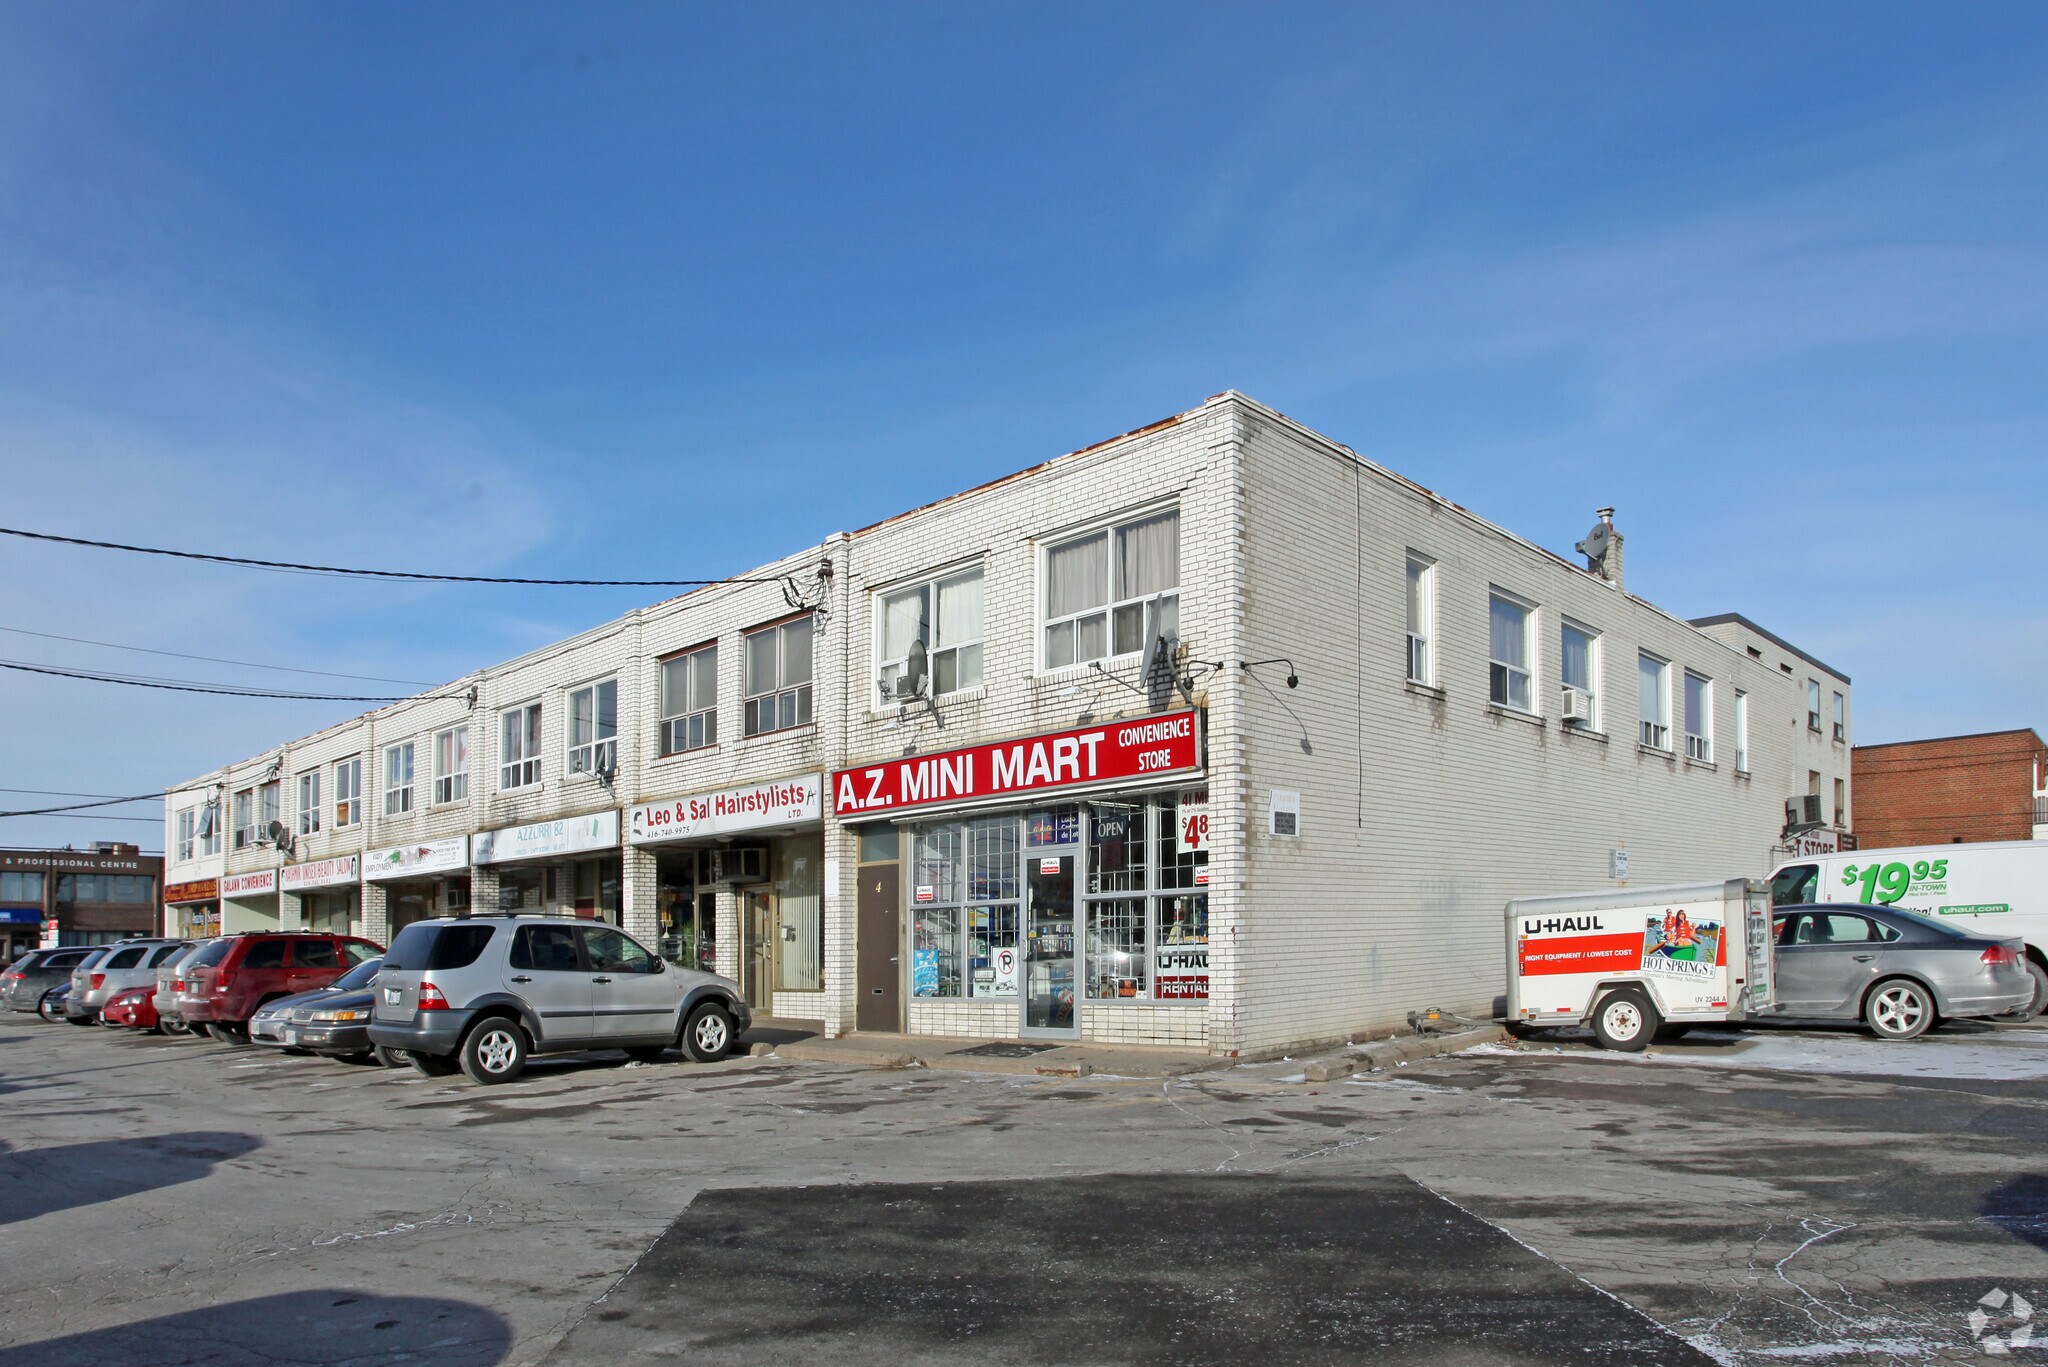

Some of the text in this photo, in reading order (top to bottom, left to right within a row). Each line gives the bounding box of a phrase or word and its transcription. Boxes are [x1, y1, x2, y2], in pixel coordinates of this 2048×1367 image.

[1119, 717, 1190, 748] CONVENIENCE
[1138, 748, 1171, 771] STORE
[836, 732, 1105, 811] A.Z. MINI MART
[646, 783, 805, 826] Leo & Sal Hairstylists
[788, 809, 803, 819] LTD.
[516, 821, 564, 841] AZZURRI 82
[647, 826, 690, 838] 416-740-9975
[1098, 821, 1124, 837] OPEN
[18, 858, 96, 868] PROFESSIONAL
[100, 861, 138, 869] CENTRE
[317, 861, 335, 878] BEAUTY
[336, 858, 351, 875] SALON
[365, 862, 394, 873] EMPLOYMENT
[241, 873, 273, 889] CONVENIENCE
[875, 882, 882, 894] 4
[1909, 884, 1947, 892] IN-TOWN
[1943, 905, 2004, 914] uhaul.com
[1524, 915, 1604, 934] U-HAUL
[1545, 952, 1582, 961] EQUIPMENT
[1587, 950, 1614, 958] LOWEST
[1643, 957, 1664, 970] HOT
[1666, 958, 1708, 975] SPRINGS
